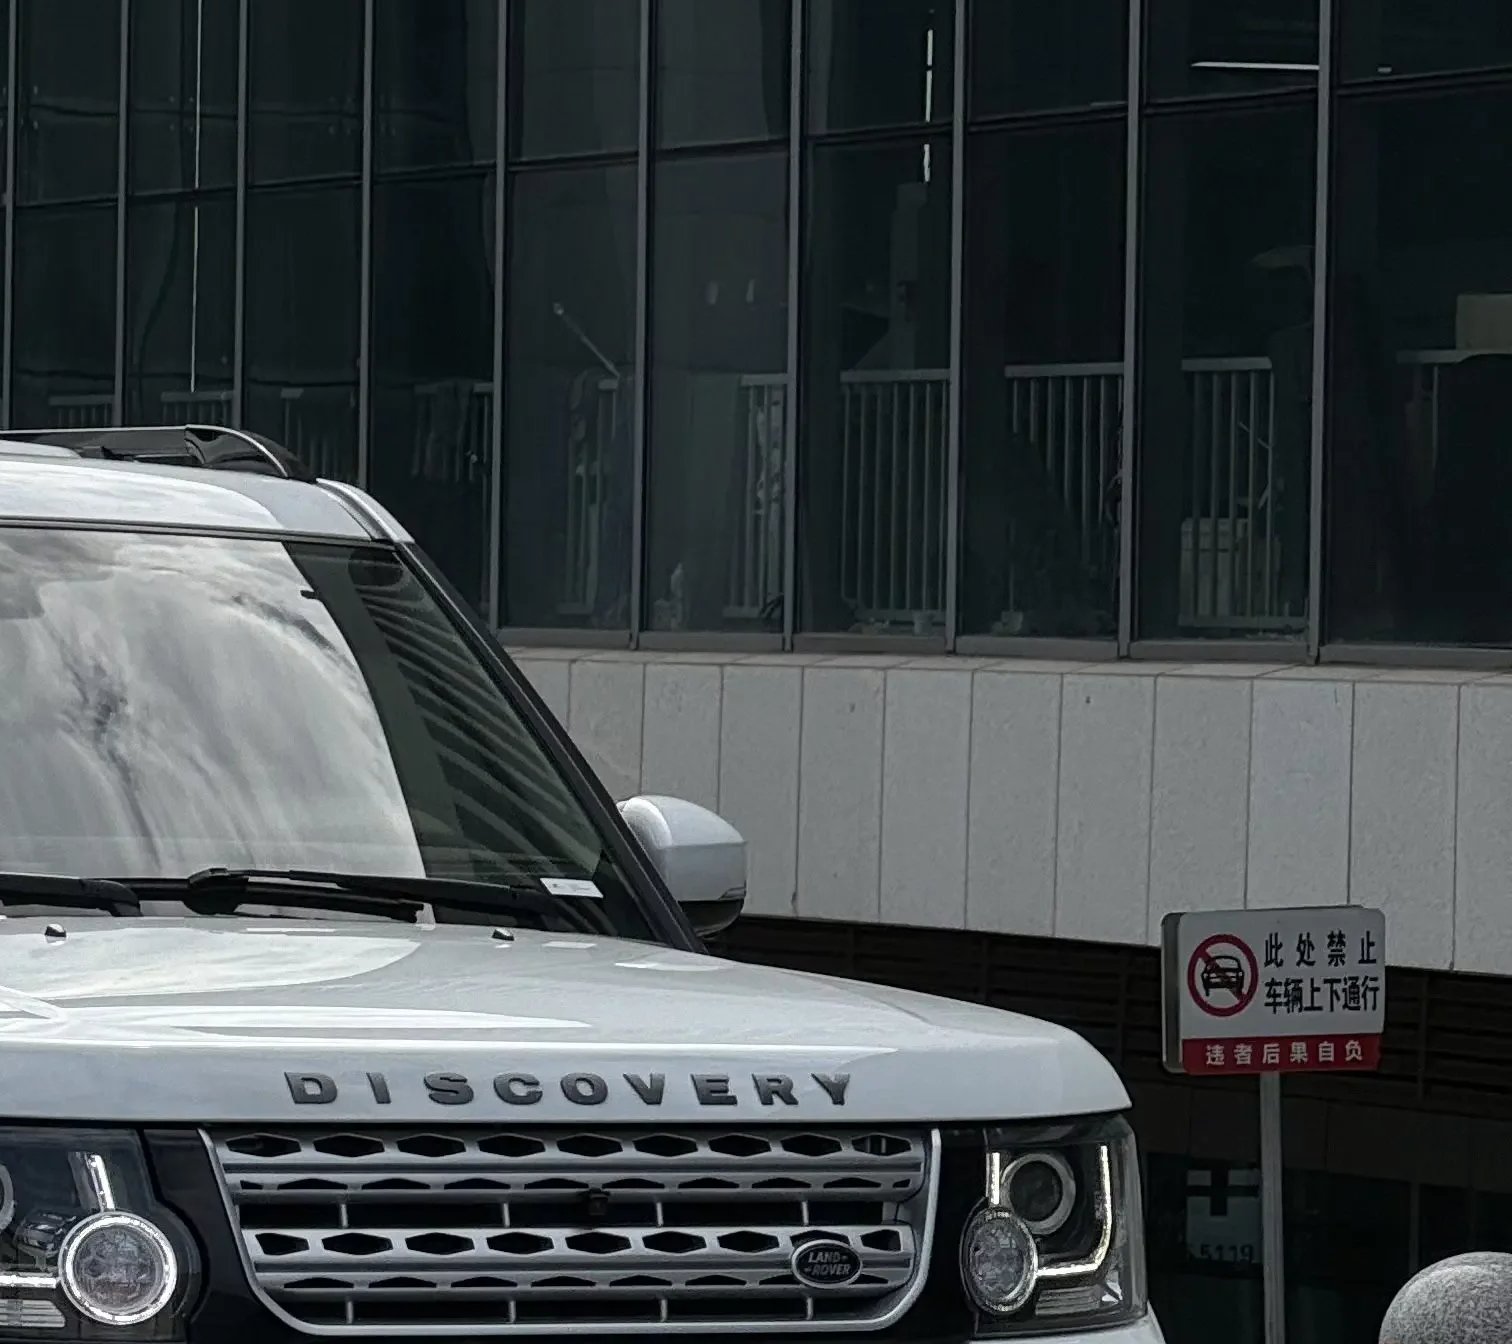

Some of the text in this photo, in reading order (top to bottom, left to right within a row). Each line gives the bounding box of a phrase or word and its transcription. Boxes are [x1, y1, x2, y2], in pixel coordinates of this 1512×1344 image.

[1264, 929, 1377, 968] 此处禁止
[1264, 975, 1379, 1015] 车辆上下通行
[1205, 1039, 1364, 1066] 违者后果自负
[285, 1071, 853, 1106] DISCOVERY
[808, 1251, 841, 1263] LAND
[811, 1263, 852, 1276] ROVER
